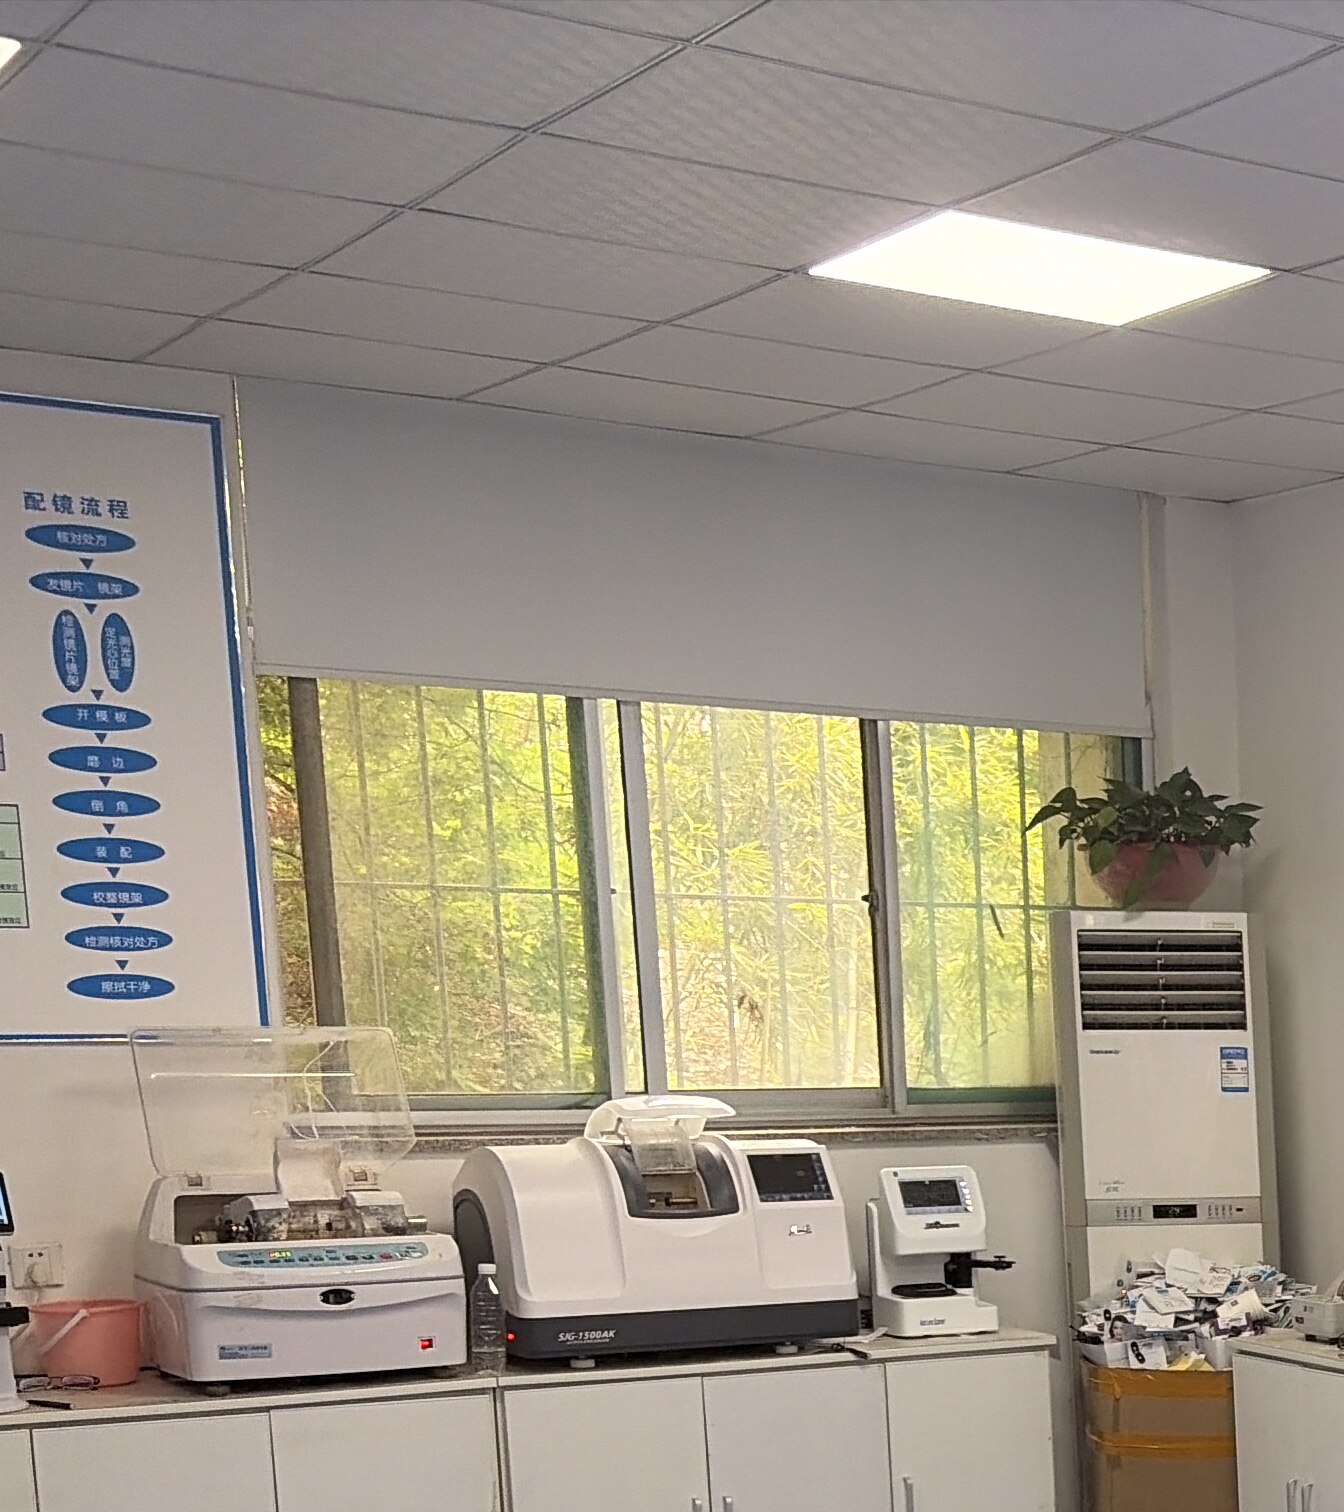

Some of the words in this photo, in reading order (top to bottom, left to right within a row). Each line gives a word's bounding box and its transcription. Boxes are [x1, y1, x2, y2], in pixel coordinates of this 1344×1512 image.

[23, 490, 131, 520] 配镜流程
[76, 708, 128, 723] 开模板
